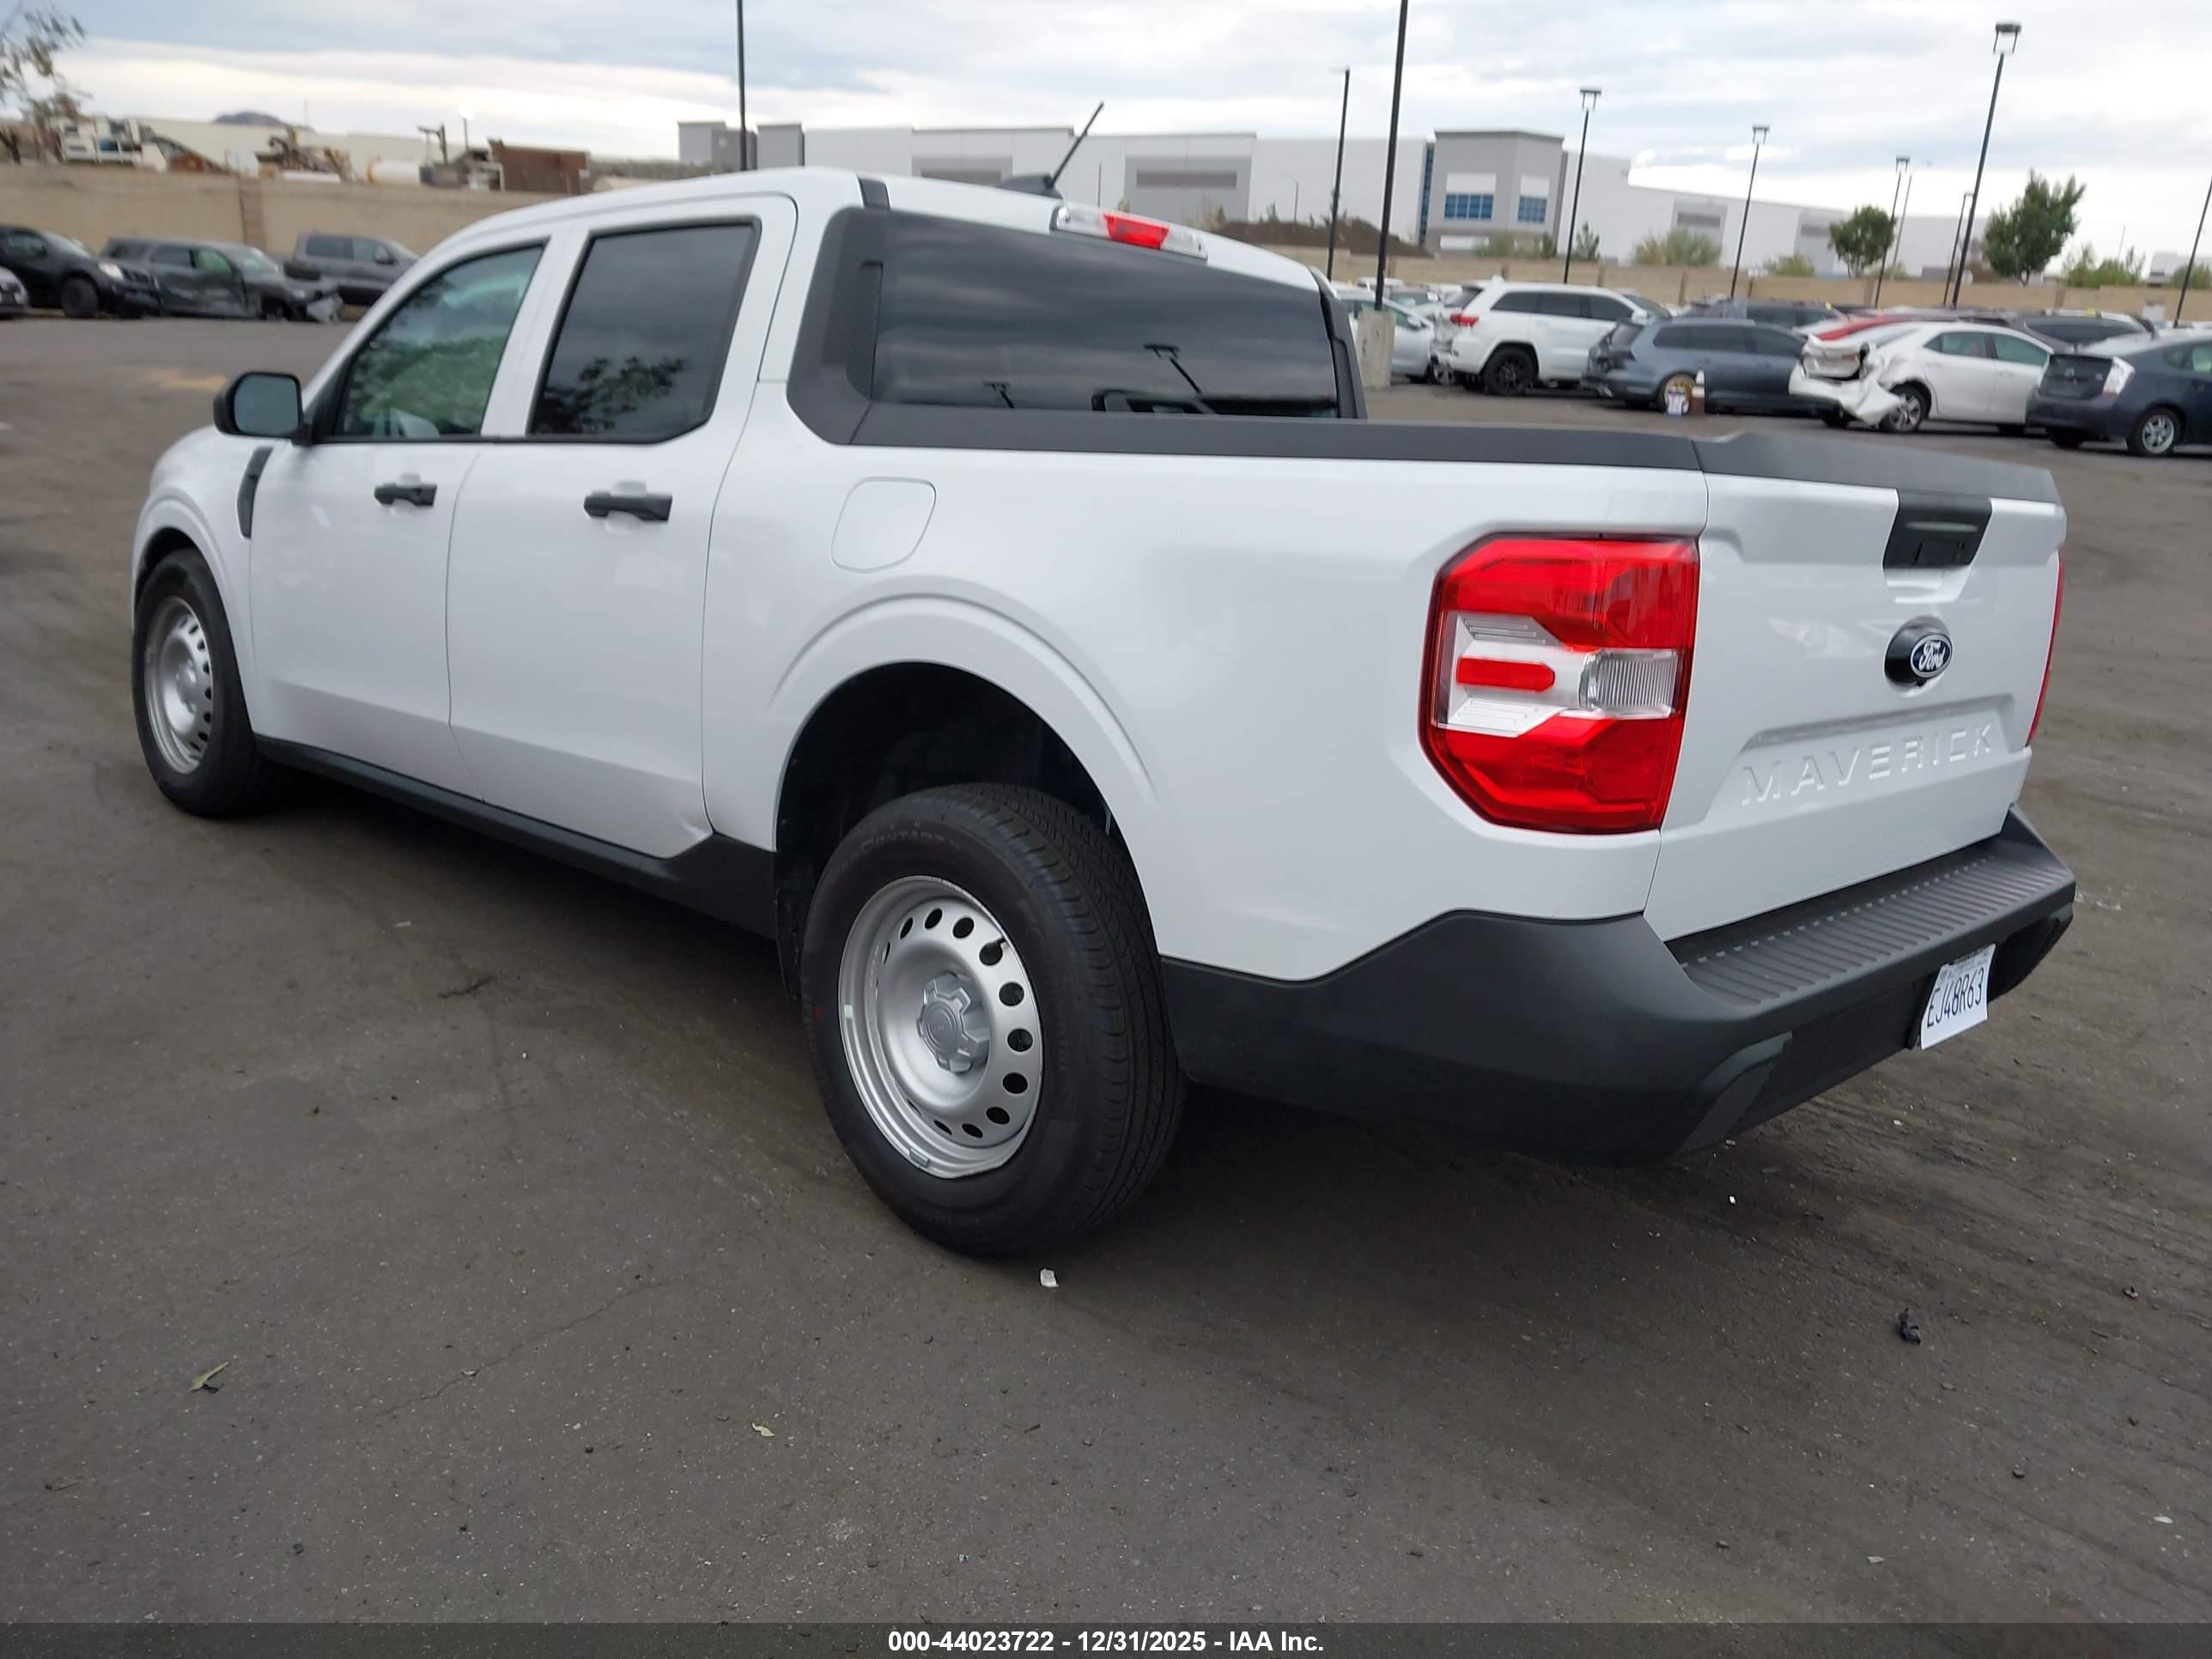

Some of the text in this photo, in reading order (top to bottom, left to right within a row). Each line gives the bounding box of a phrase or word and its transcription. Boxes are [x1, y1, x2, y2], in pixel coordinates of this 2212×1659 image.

[1918, 641, 1947, 671] Ford
[1741, 723, 1992, 806] MAVERICK
[1926, 967, 1984, 1028] EJ48R63
